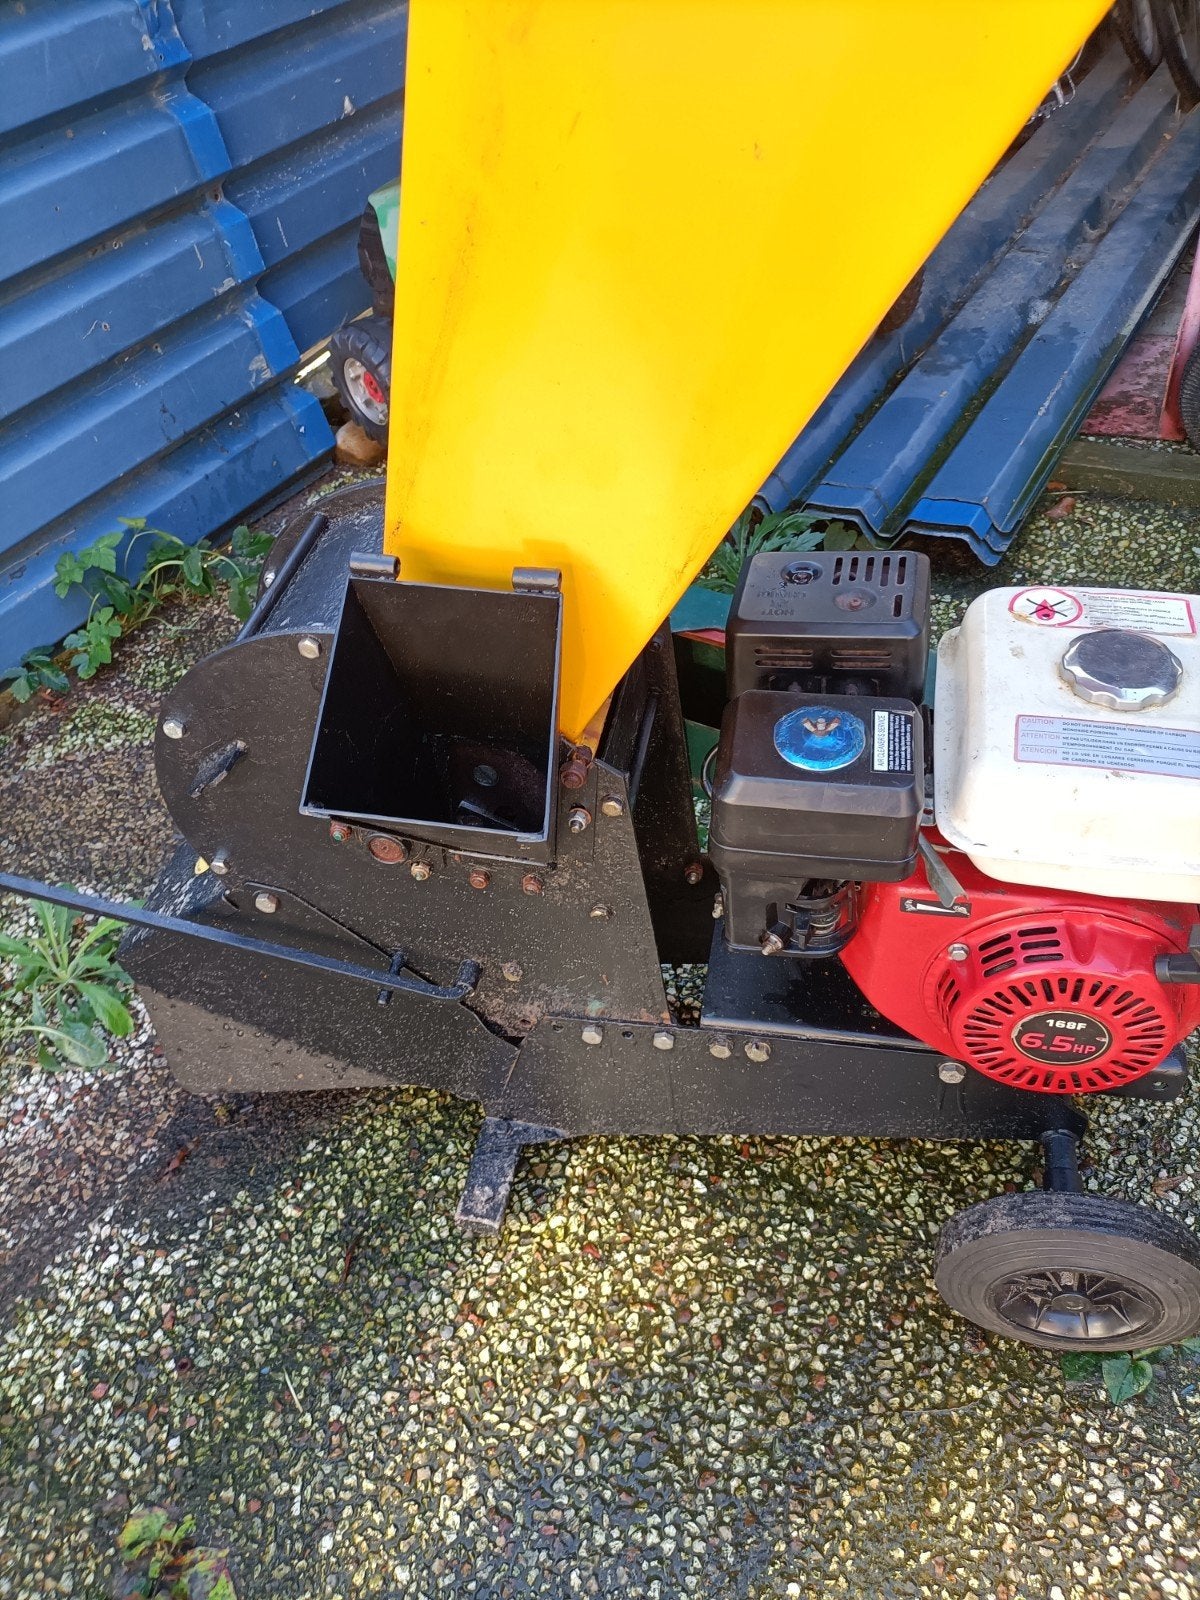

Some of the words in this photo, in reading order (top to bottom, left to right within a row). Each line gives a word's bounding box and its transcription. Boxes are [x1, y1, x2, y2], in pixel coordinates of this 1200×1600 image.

[877, 715, 885, 733] SERVICE
[1022, 717, 1054, 725] CAUTION
[1046, 1019, 1087, 1031] 168F
